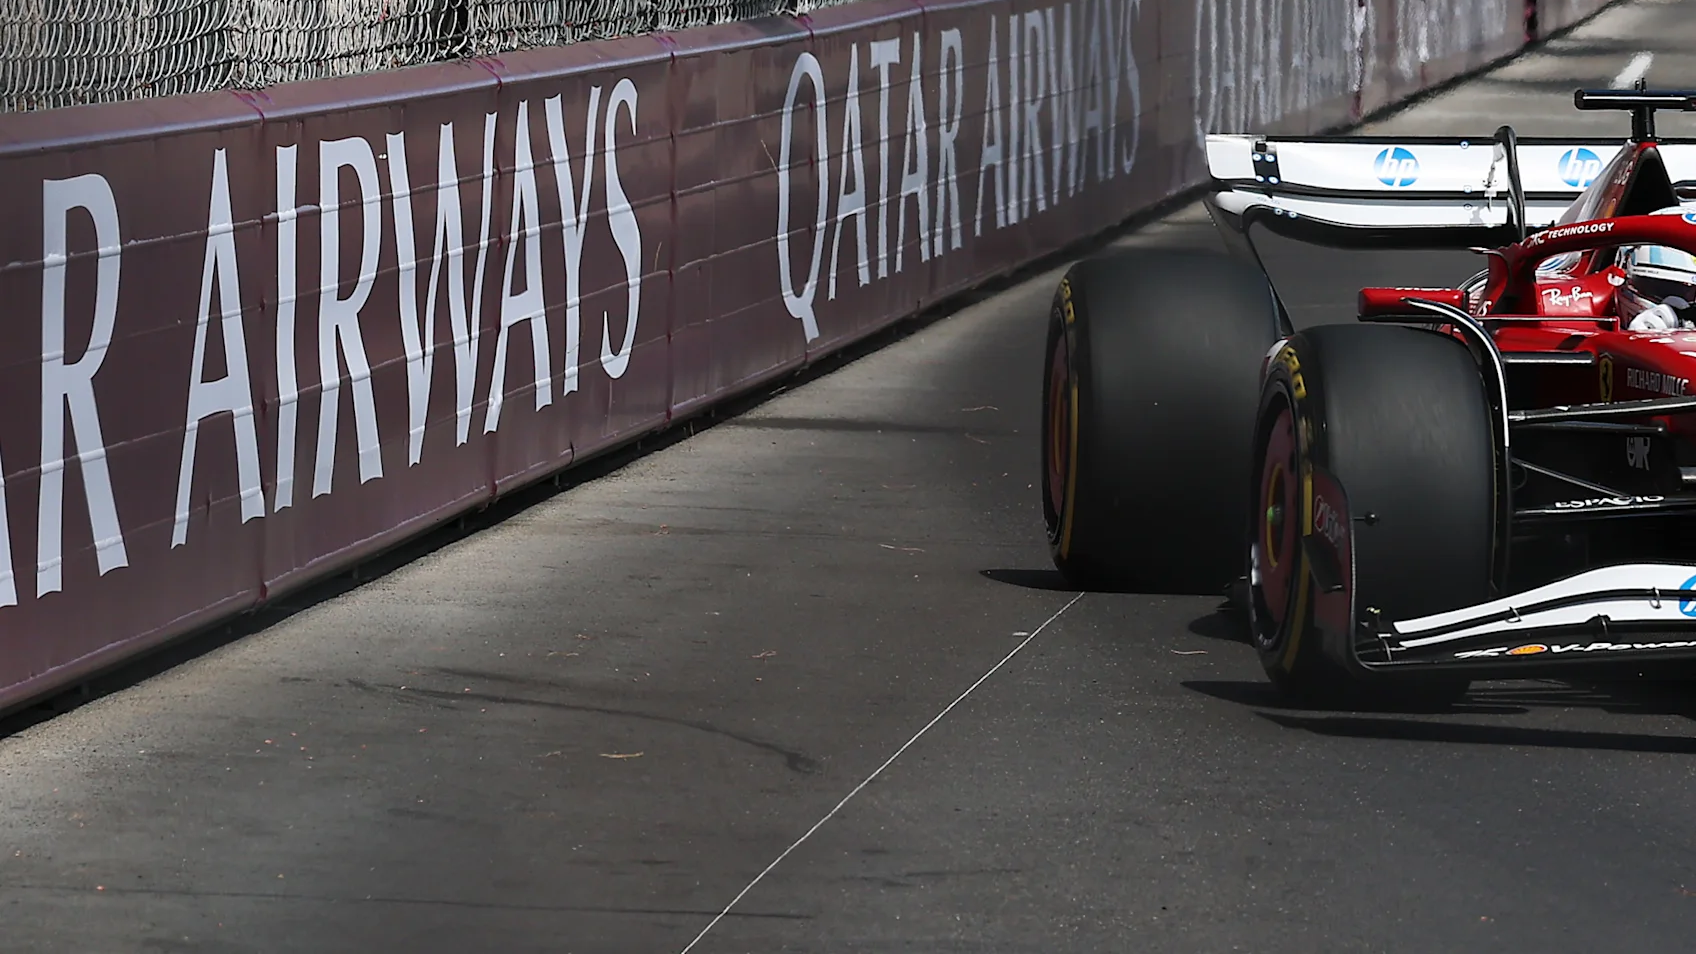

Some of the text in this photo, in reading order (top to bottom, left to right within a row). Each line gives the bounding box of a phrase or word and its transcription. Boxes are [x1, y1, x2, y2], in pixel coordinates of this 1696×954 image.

[778, 28, 963, 344] QATAR
[1372, 147, 1418, 187] hp
[1548, 222, 1614, 239] TECHNOLOGY
[0, 77, 643, 608] R AIRWAYS
[1627, 368, 1689, 396] RICHARD MILLE
